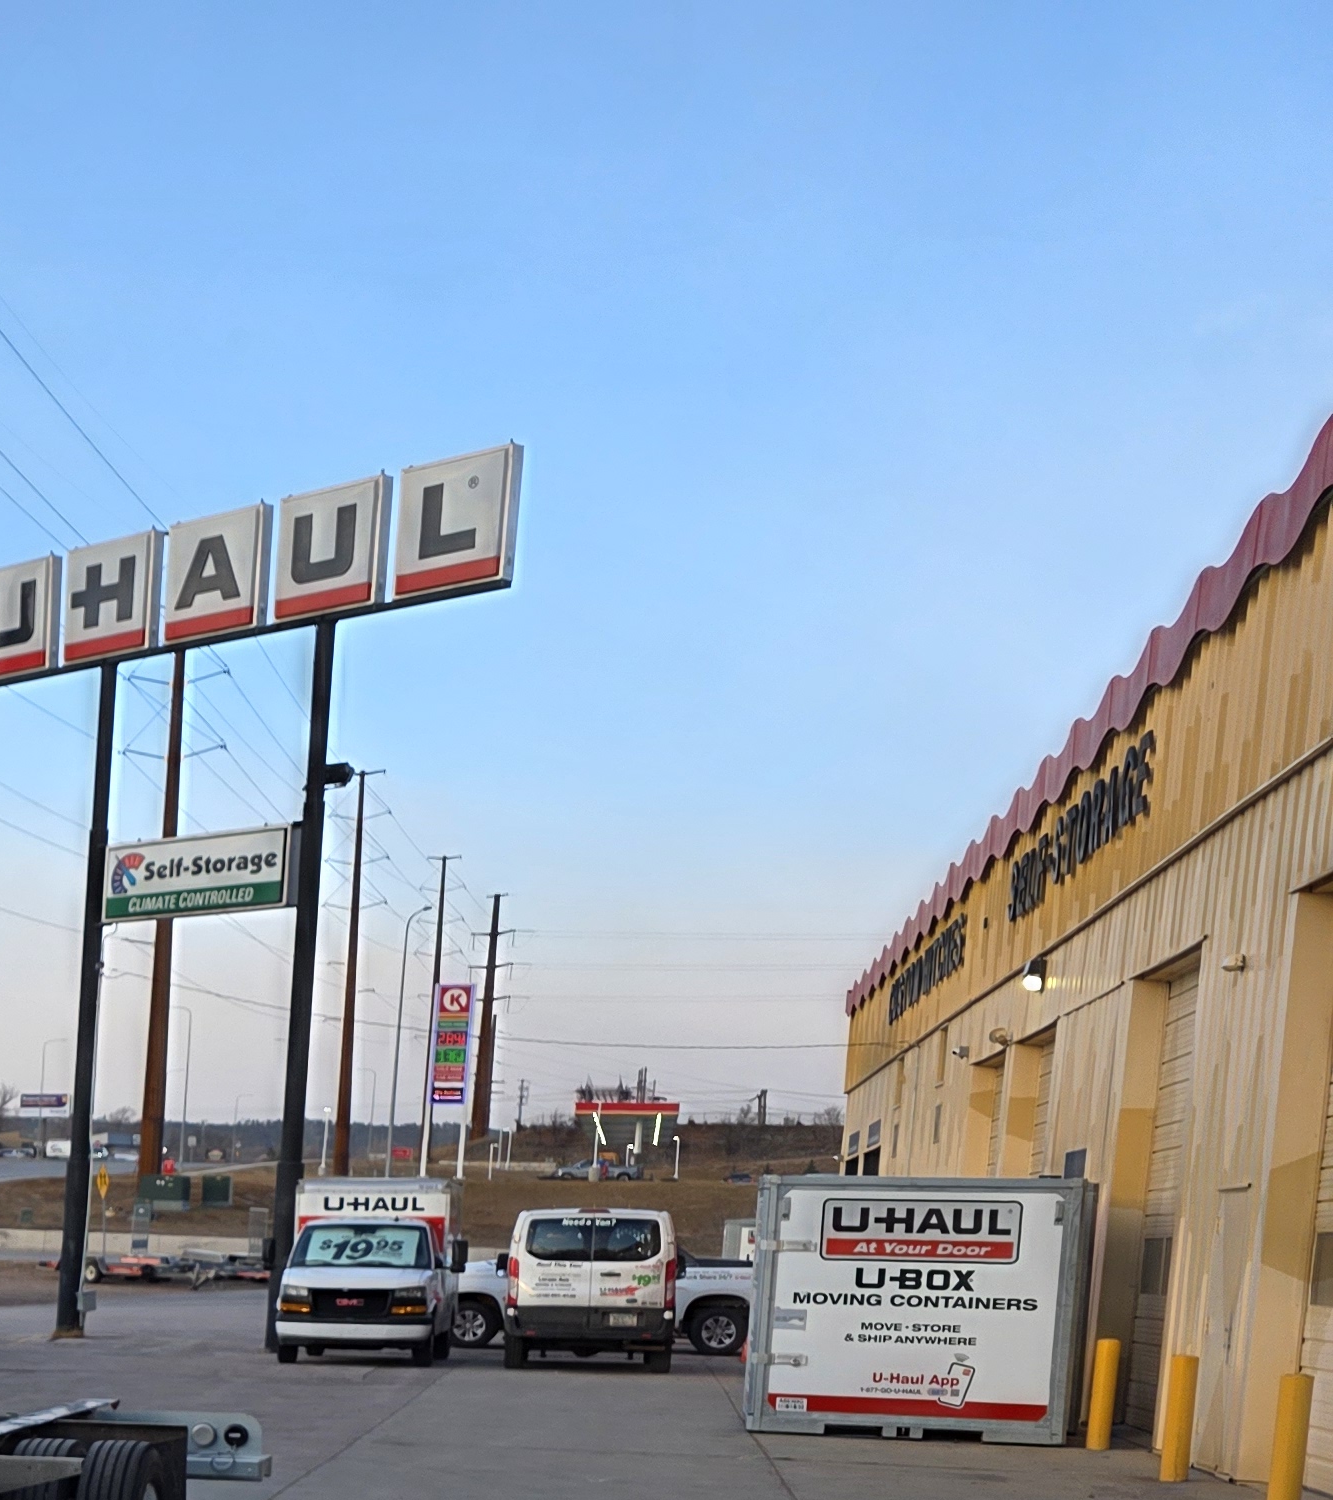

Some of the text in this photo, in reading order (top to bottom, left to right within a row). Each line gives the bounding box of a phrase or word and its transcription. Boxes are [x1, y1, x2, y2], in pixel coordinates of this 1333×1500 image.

[144, 852, 278, 881] Self-Storage
[128, 886, 255, 913] CLIMATE CONTROLLED
[324, 1196, 425, 1212] U-HAUL
[562, 1217, 586, 1226] Need
[595, 1217, 617, 1227] Van?
[832, 1206, 1012, 1236] U-HAUL
[853, 1242, 991, 1256] At Your Door
[855, 1267, 975, 1292] U-BOX
[793, 1292, 1039, 1312] MOVING CONTAINERS
[861, 1322, 961, 1334] MOVE STORE
[844, 1333, 977, 1346] & SHIP ANYWHERE
[873, 1372, 960, 1388] U-Haul App
